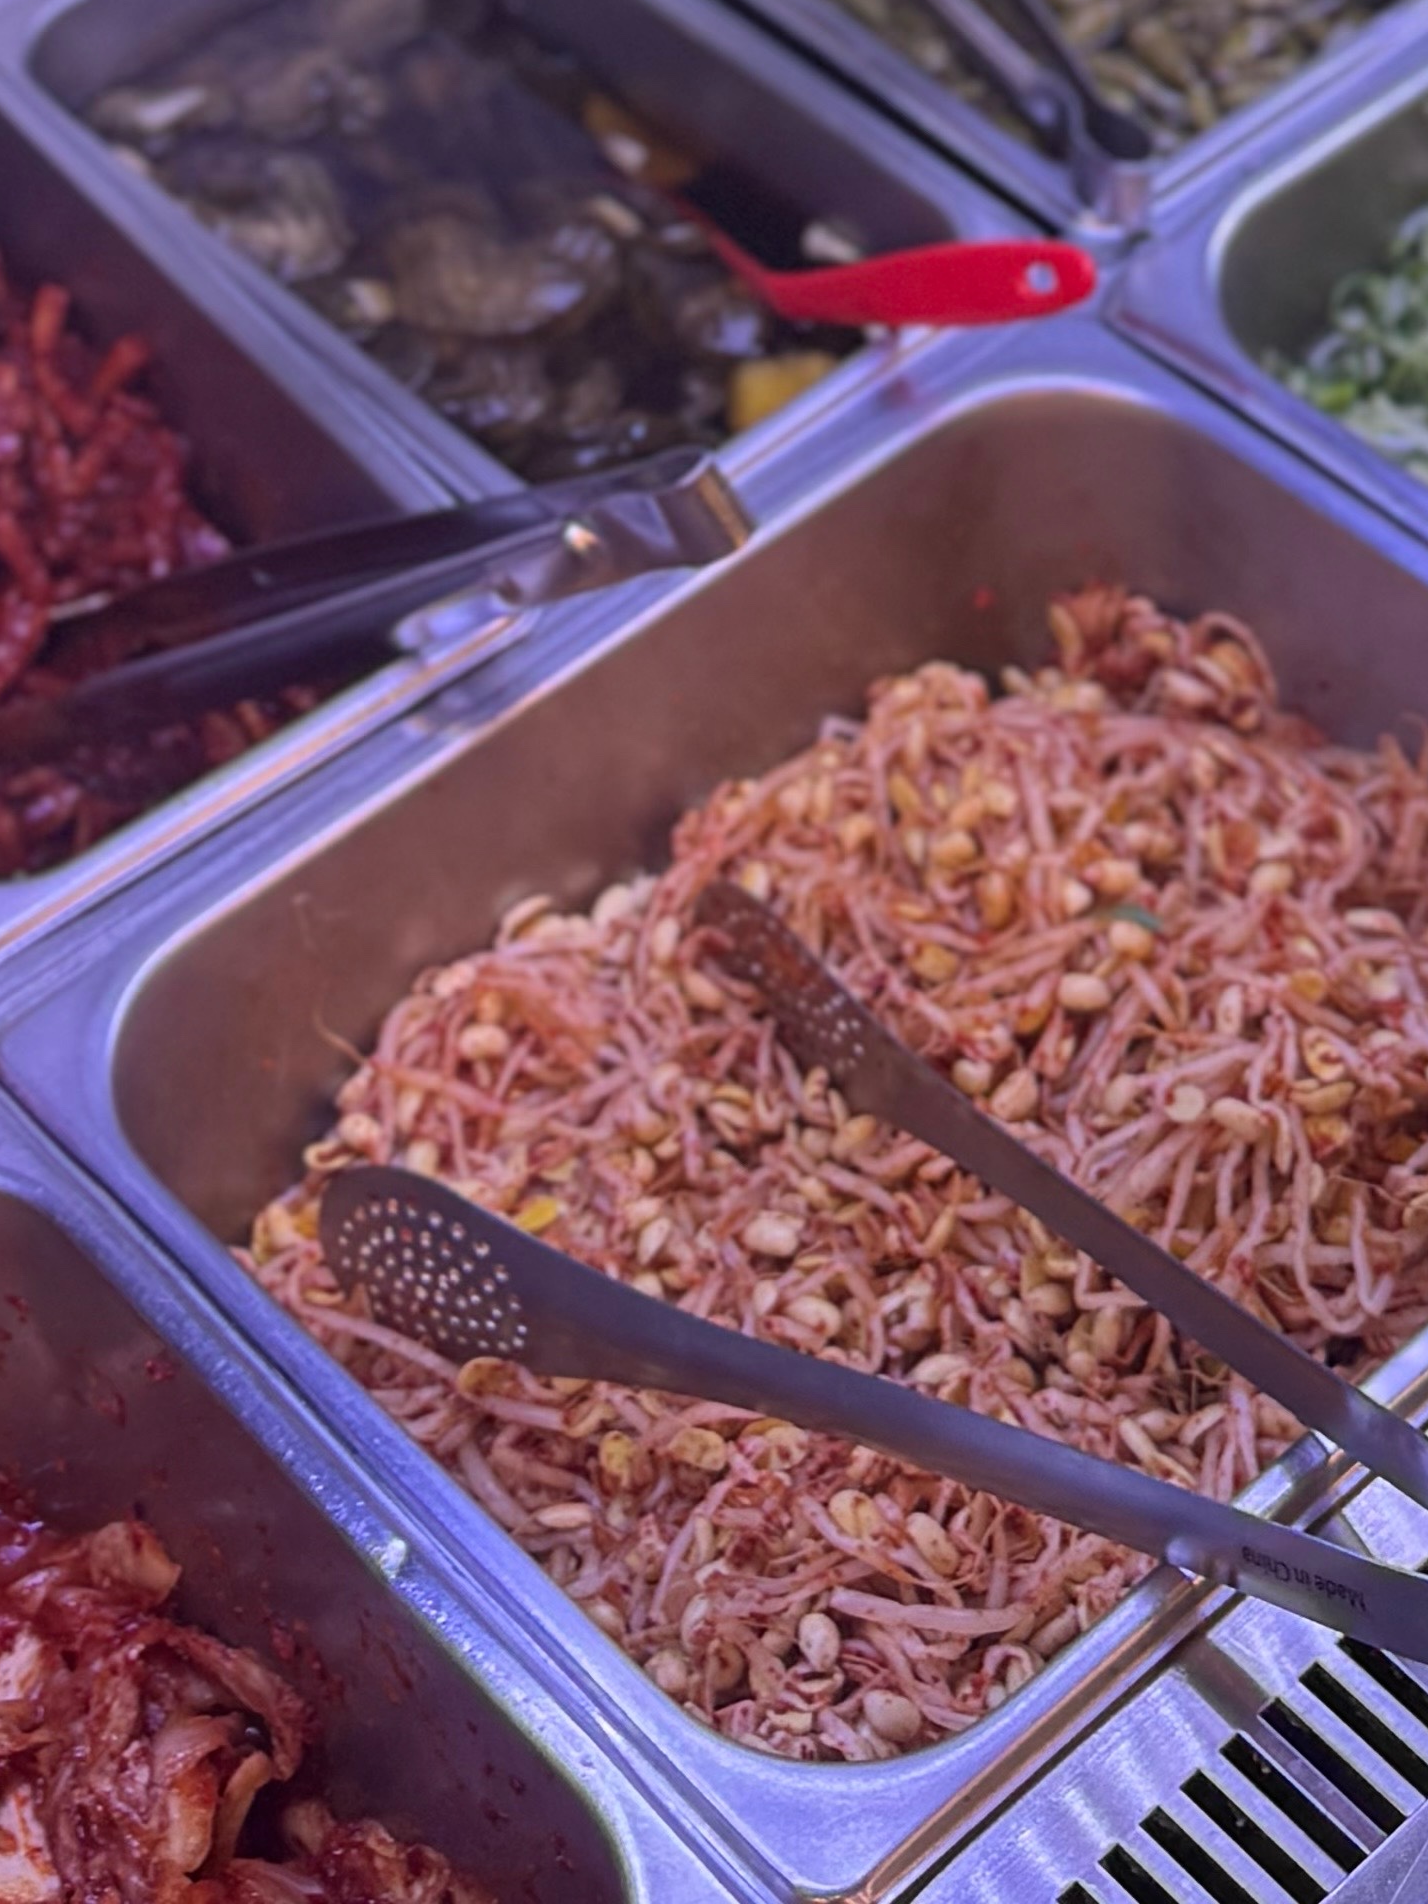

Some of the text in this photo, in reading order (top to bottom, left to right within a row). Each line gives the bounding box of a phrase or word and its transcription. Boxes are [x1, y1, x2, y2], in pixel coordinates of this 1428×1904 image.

[1241, 1546, 1366, 1611] Made in China
